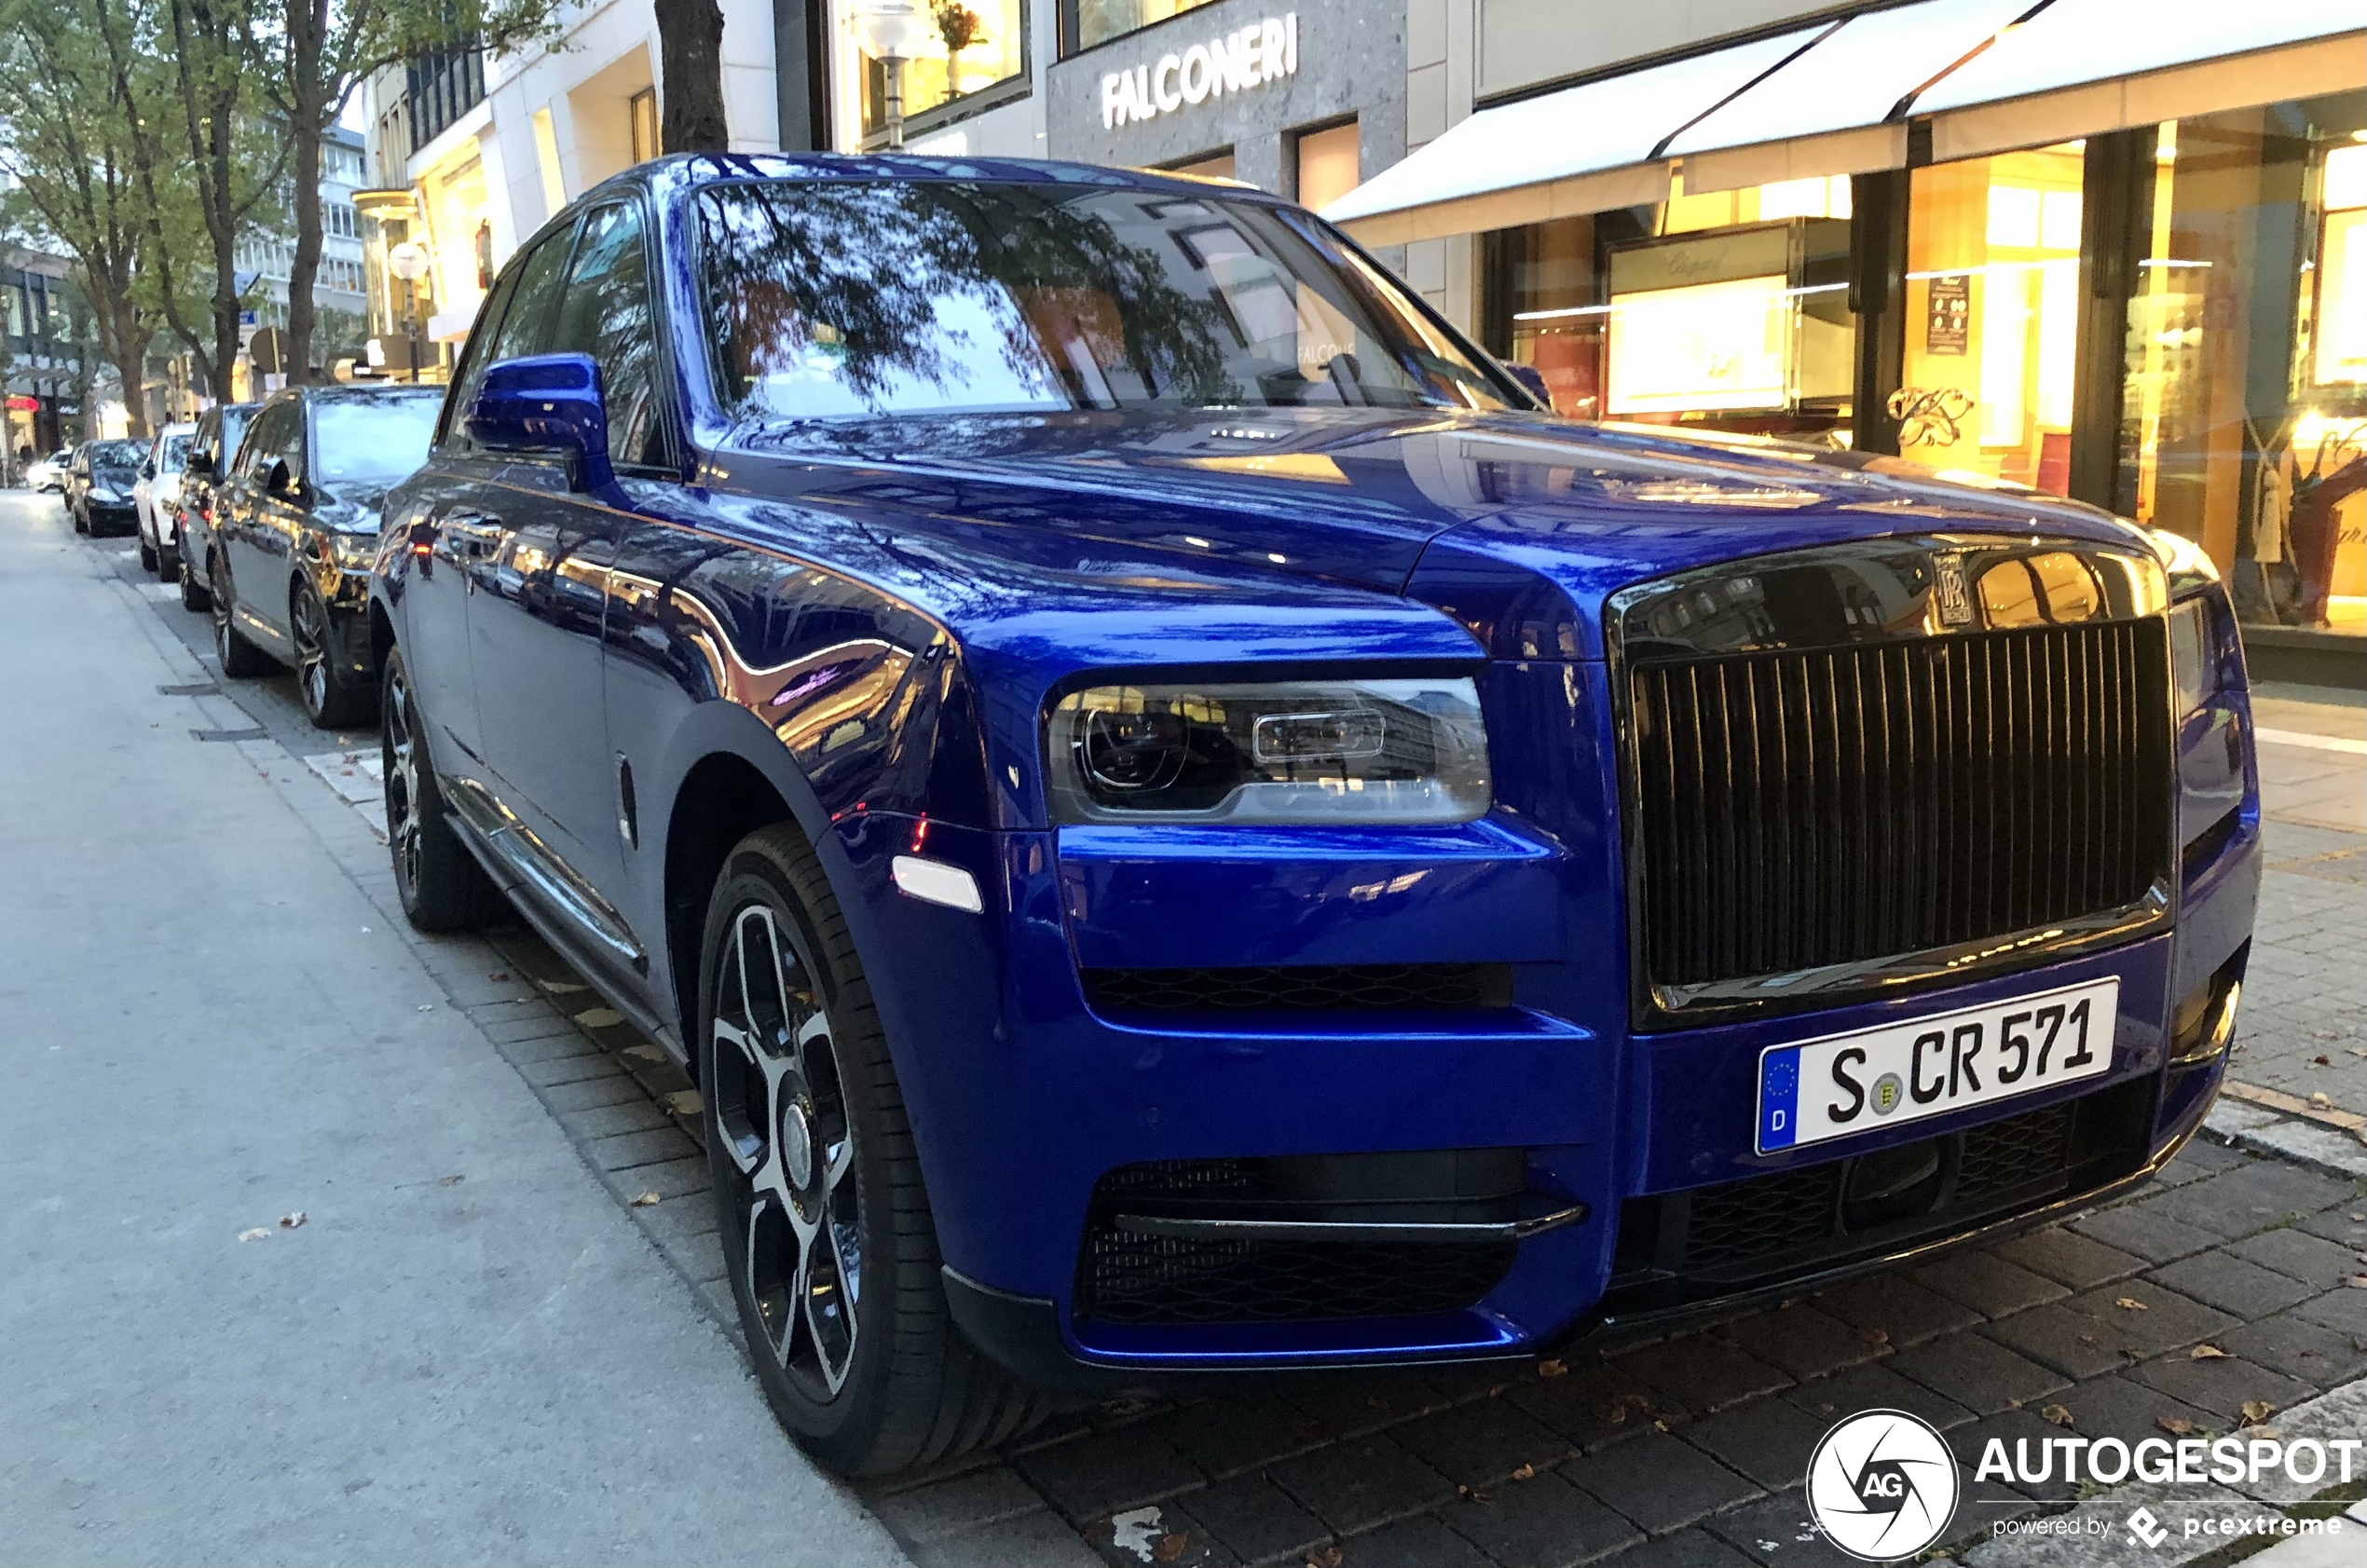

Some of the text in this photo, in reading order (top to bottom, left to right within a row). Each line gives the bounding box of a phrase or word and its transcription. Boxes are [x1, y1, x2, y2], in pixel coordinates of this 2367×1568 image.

[1102, 12, 1297, 130] FALCONERI
[1828, 998, 2093, 1123] S CR 571
[1772, 1110, 1786, 1132] D
